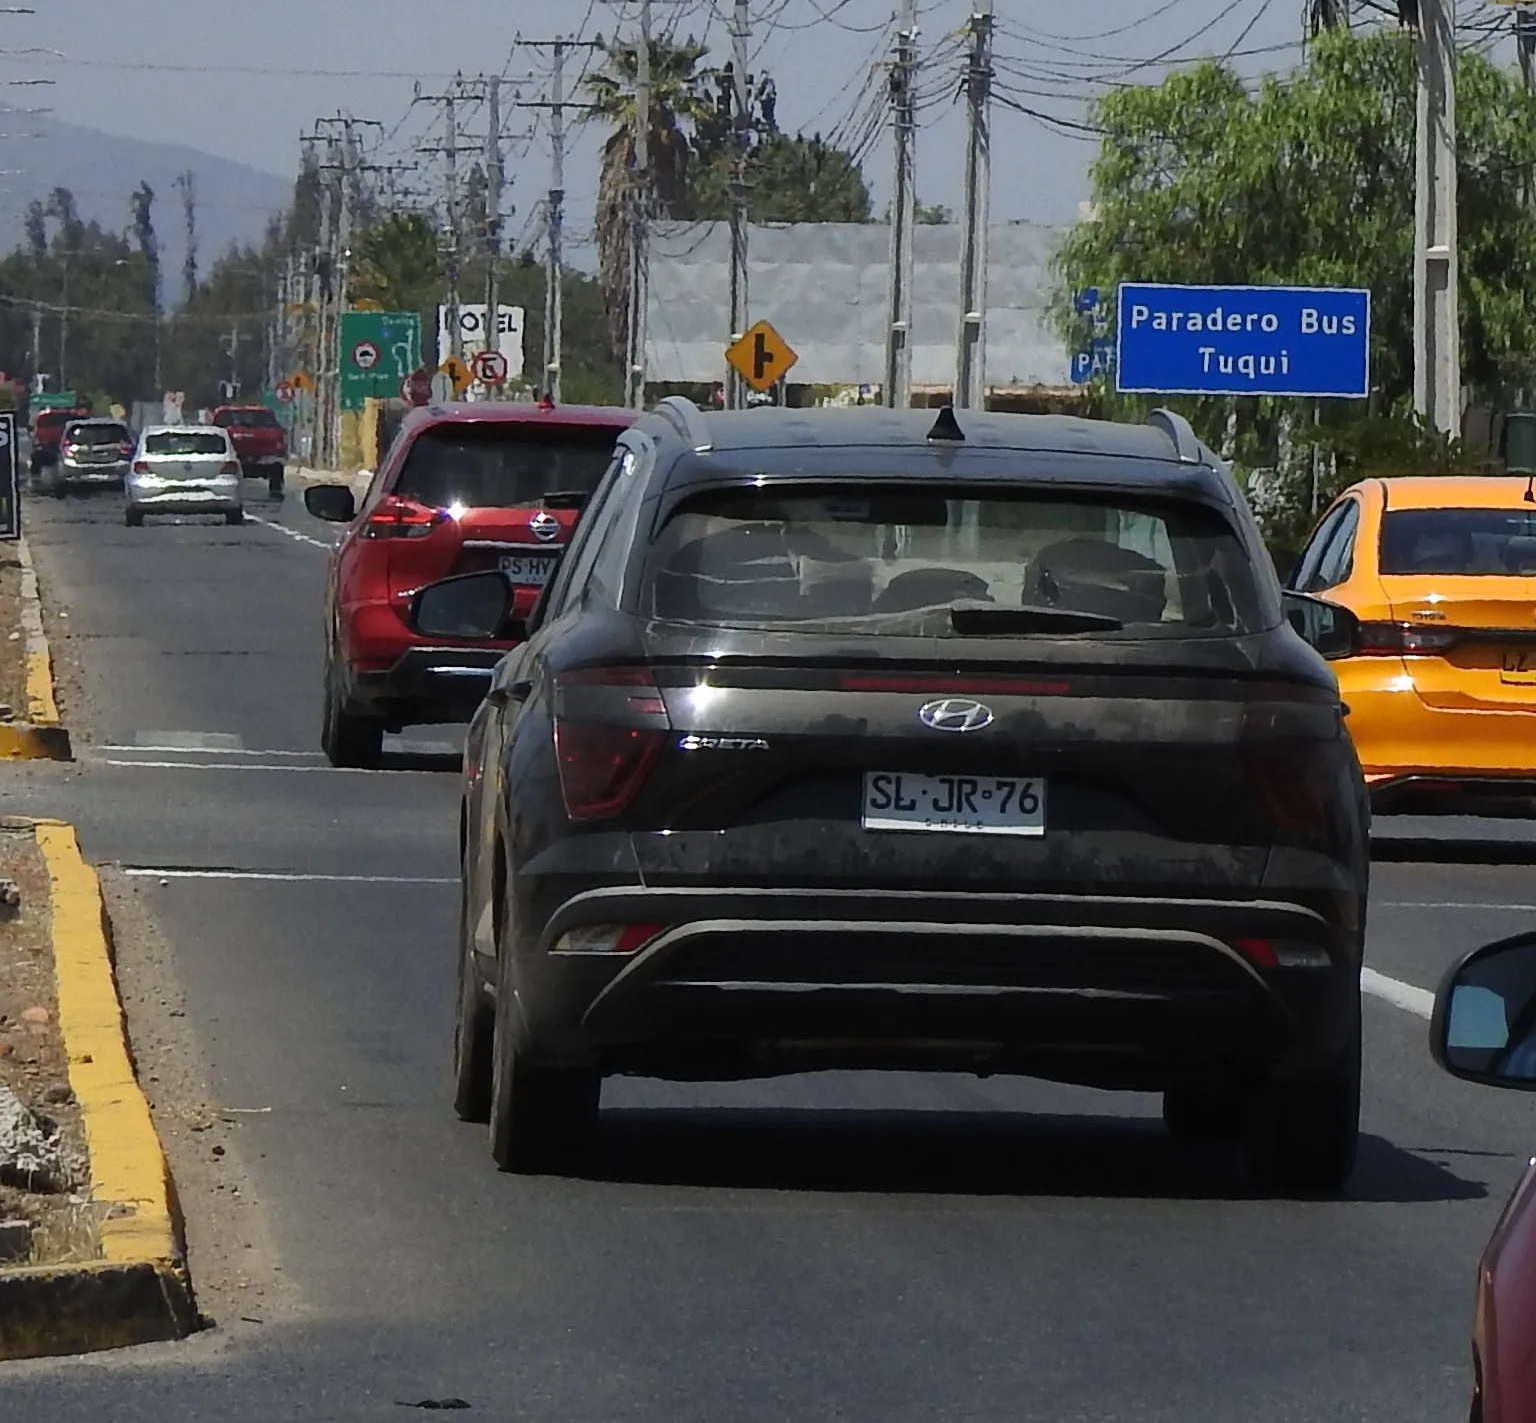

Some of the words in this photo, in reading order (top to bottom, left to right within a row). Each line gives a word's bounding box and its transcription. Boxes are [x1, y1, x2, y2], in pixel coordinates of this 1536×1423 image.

[1131, 305, 1278, 332] Paradero
[1301, 308, 1356, 335] Bus
[1199, 347, 1289, 379] Tuqui
